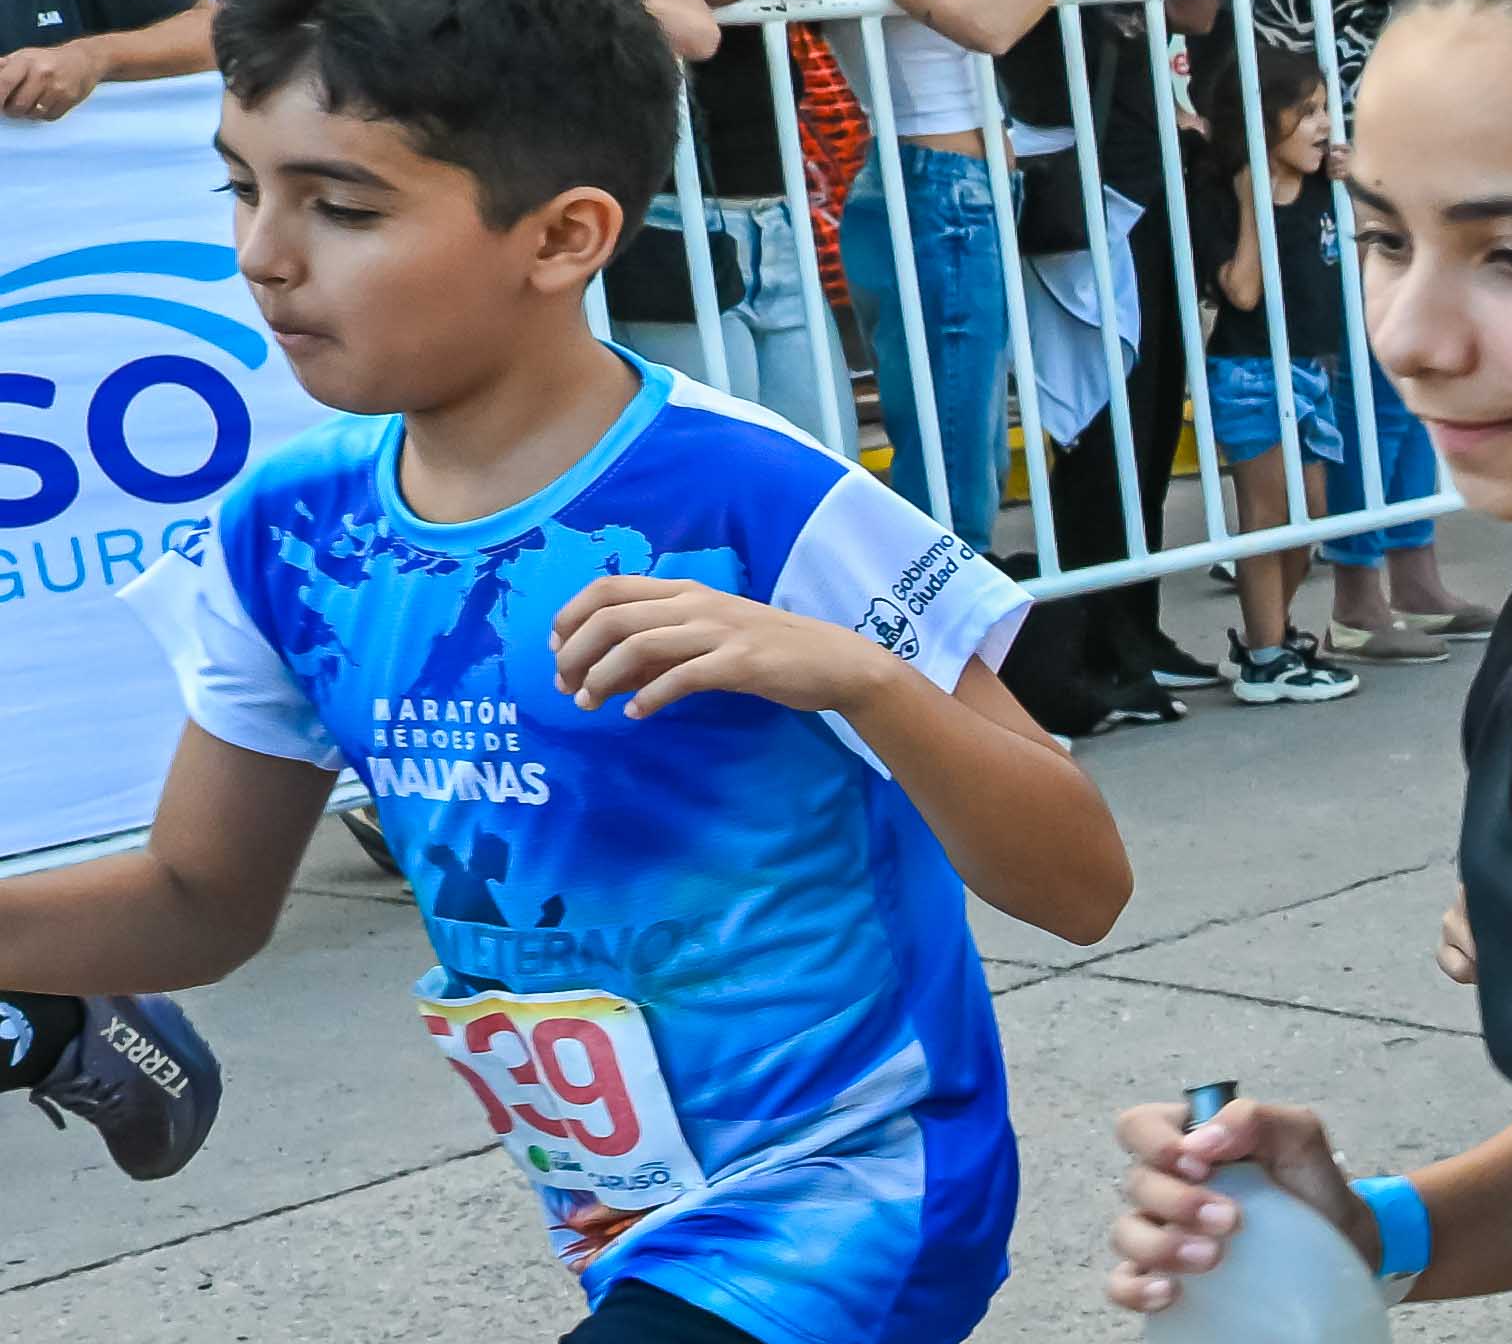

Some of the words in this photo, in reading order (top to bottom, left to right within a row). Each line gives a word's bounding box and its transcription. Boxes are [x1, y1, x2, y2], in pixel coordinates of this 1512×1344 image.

[907, 556, 960, 616] Ciudad
[373, 697, 518, 725] MARATÓN
[373, 724, 476, 751] HÉROES
[483, 732, 521, 752] DE
[366, 756, 551, 806] MALVINAS
[100, 1016, 189, 1099] TERREX
